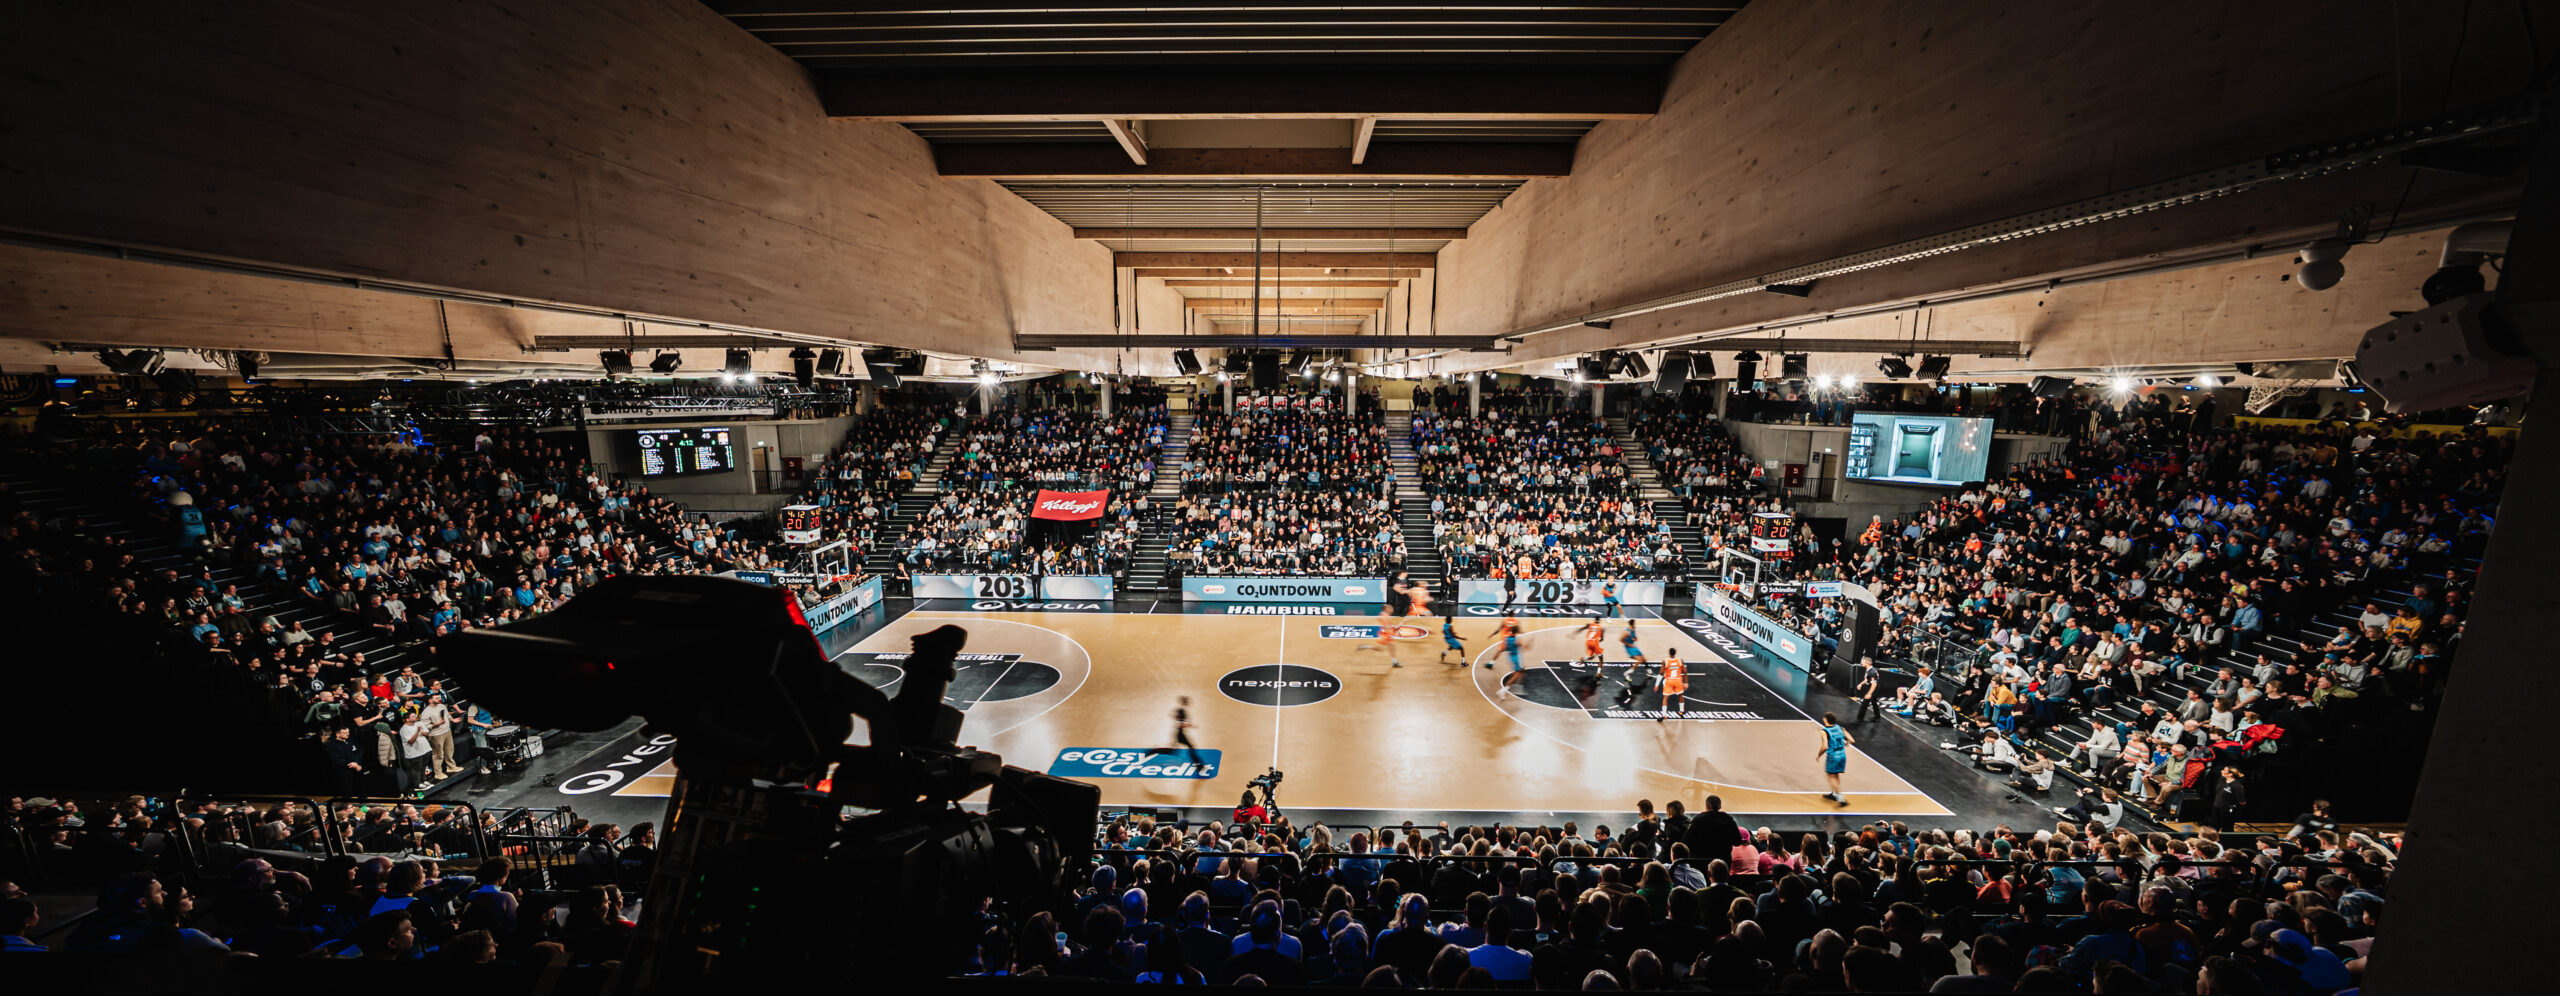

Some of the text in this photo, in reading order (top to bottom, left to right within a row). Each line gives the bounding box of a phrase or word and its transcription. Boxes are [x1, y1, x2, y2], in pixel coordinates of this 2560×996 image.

[1041, 499, 1100, 514] Kellogg's
[787, 518, 803, 529] 20
[810, 516, 820, 529] 20
[1752, 524, 1763, 536] 20
[1770, 526, 1787, 538] 20
[979, 577, 1025, 598] 203
[1527, 581, 1574, 603] 203
[1011, 602, 1101, 610] VEOLIA
[1227, 605, 1335, 615] HAMBURG
[1697, 628, 1755, 659] VEOLIA
[1229, 679, 1332, 689] nexperia
[1604, 710, 1646, 719] MORE
[1101, 761, 1215, 777] Credit
